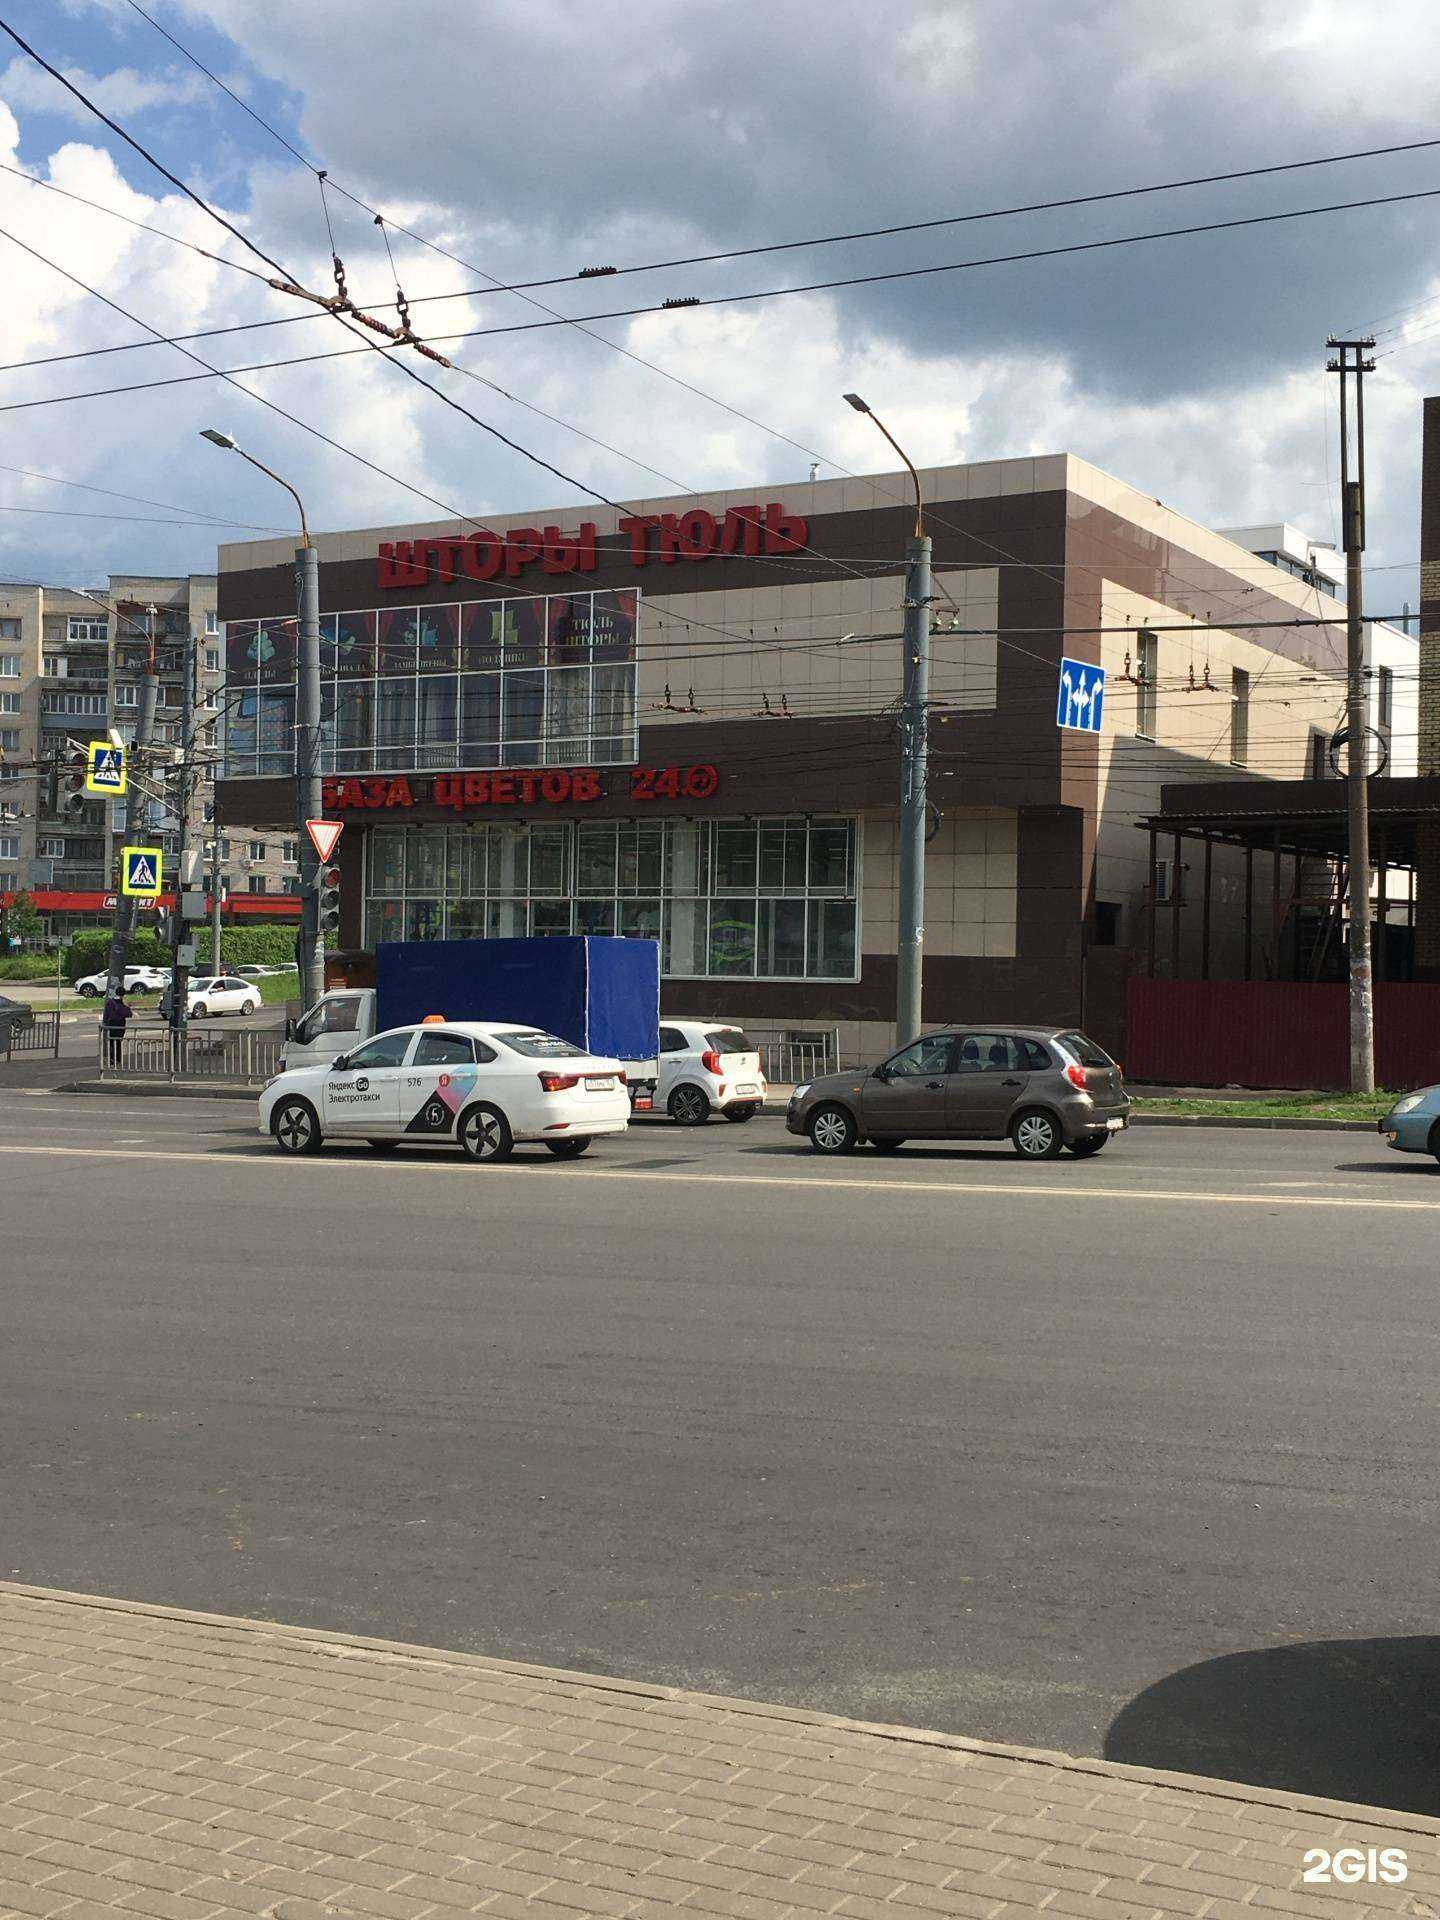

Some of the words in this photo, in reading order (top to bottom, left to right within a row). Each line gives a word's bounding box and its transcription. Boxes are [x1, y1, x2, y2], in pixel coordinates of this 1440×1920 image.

[378, 522, 596, 588] ШТОРЫ
[619, 503, 808, 566] ТЮЛЬ
[435, 767, 600, 811] ЦВЕТОВ
[328, 1081, 355, 1091] Яндекс
[356, 1080, 369, 1090] Go
[407, 1077, 422, 1087] 576
[328, 1093, 381, 1103] Электротакси
